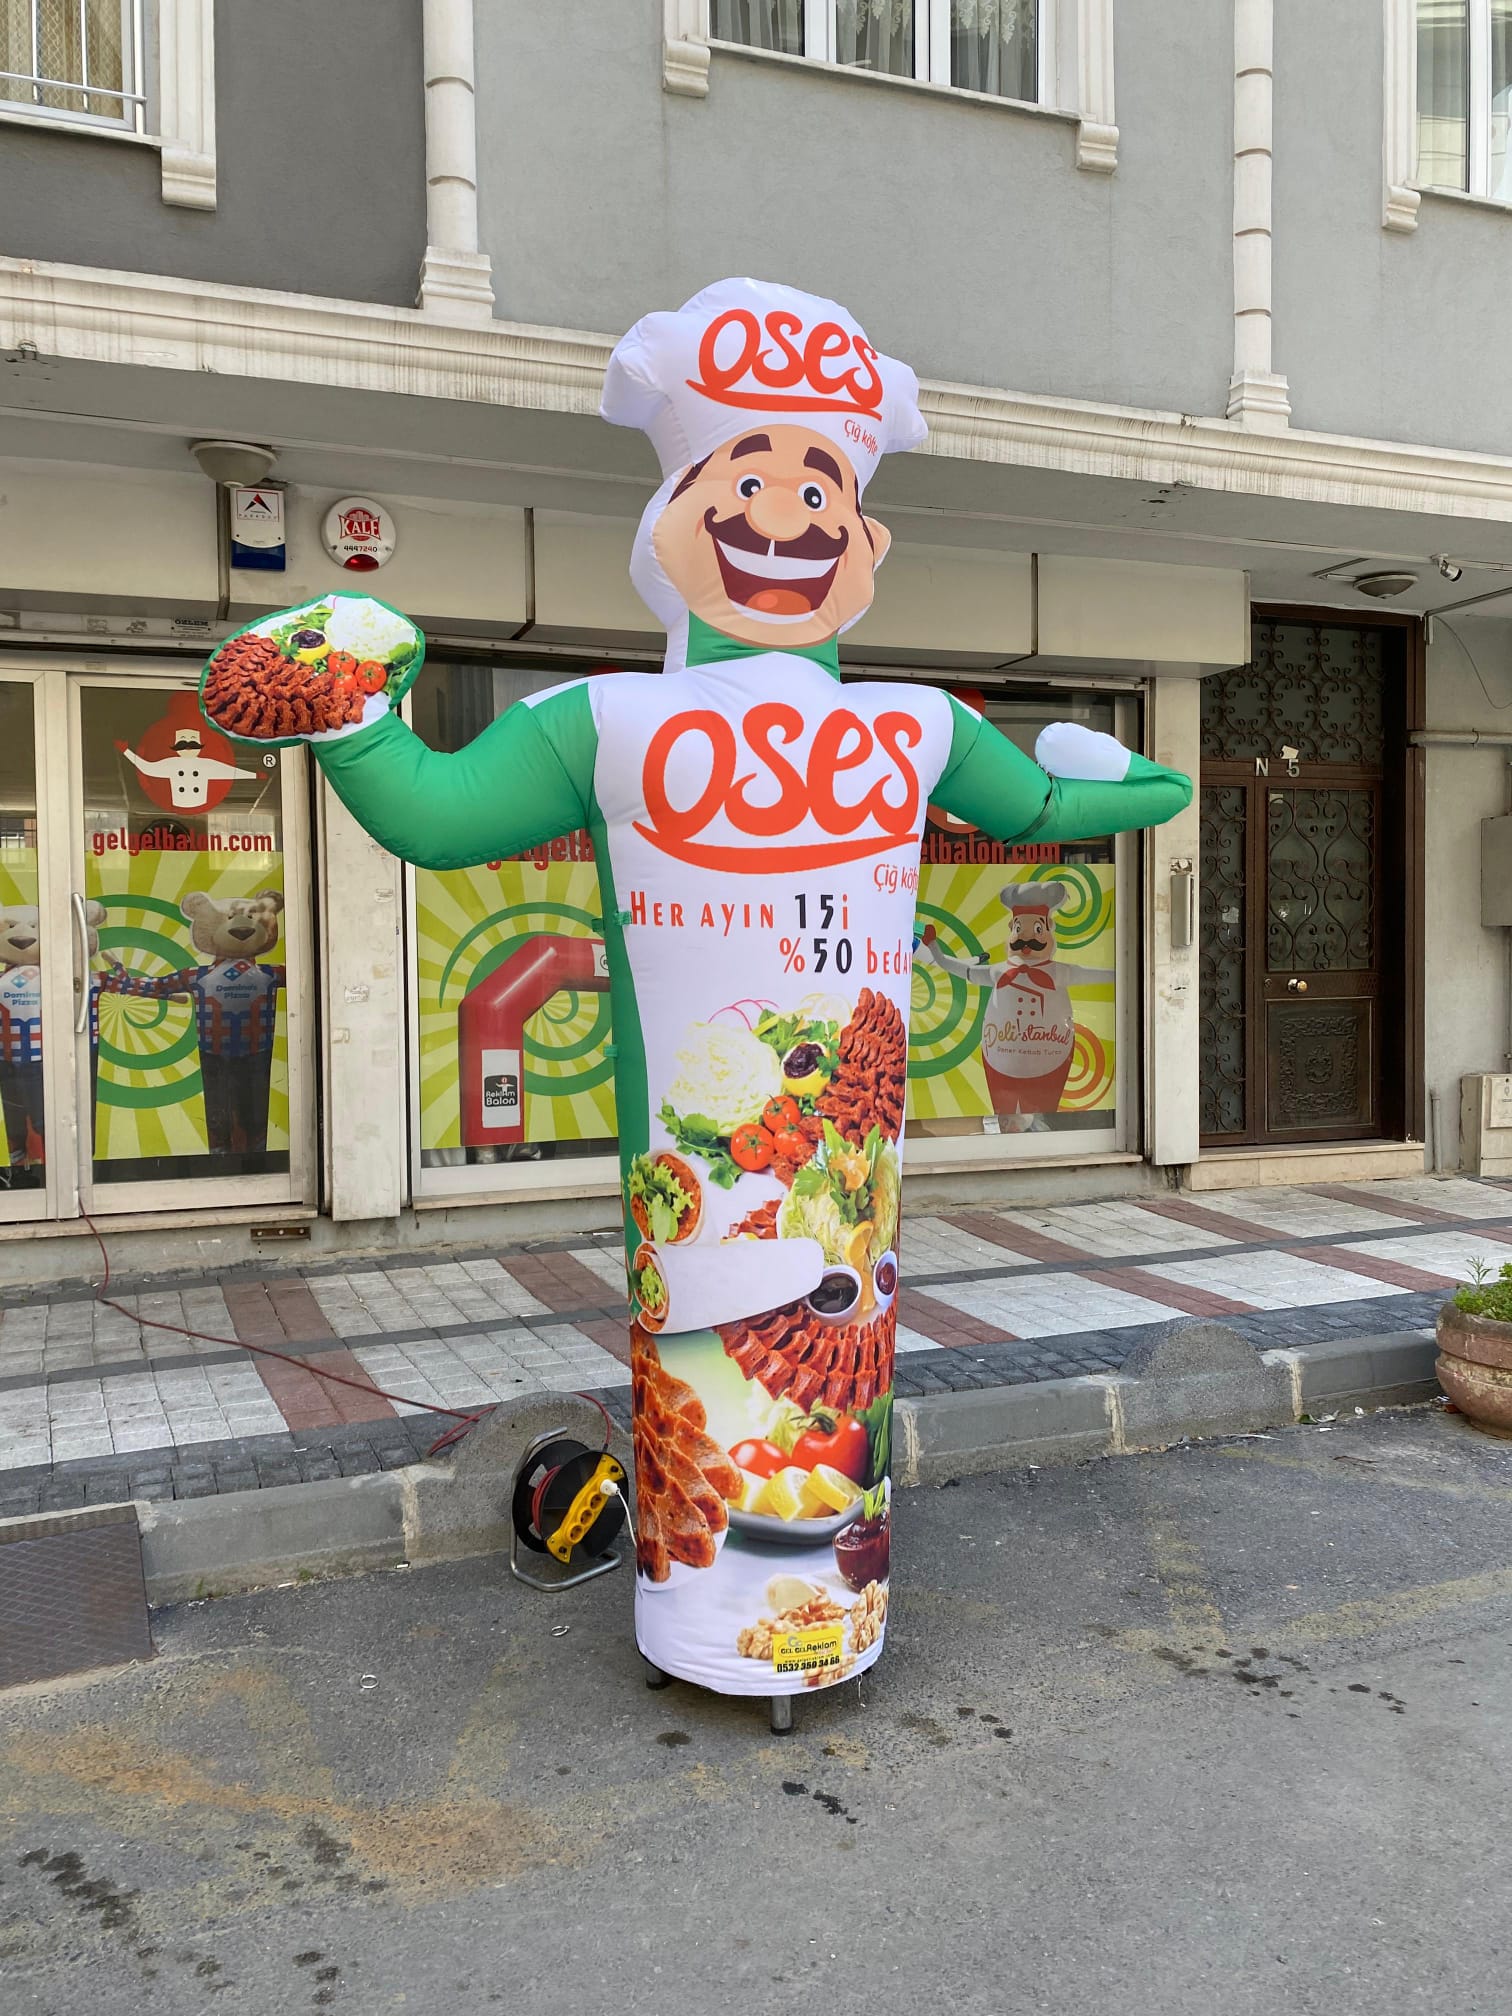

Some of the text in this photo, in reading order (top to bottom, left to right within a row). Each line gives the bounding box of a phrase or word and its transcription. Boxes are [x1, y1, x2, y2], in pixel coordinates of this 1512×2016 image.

[686, 309, 883, 421] Oses
[844, 419, 861, 443] Çiğ
[340, 516, 380, 539] KALE
[1255, 757, 1300, 778] N 5
[632, 702, 922, 874] Oses
[92, 827, 272, 857] gelgelbalon.com
[873, 863, 898, 894] Çiğ
[779, 936, 853, 974] %50
[777, 1662, 800, 1673] 0532
